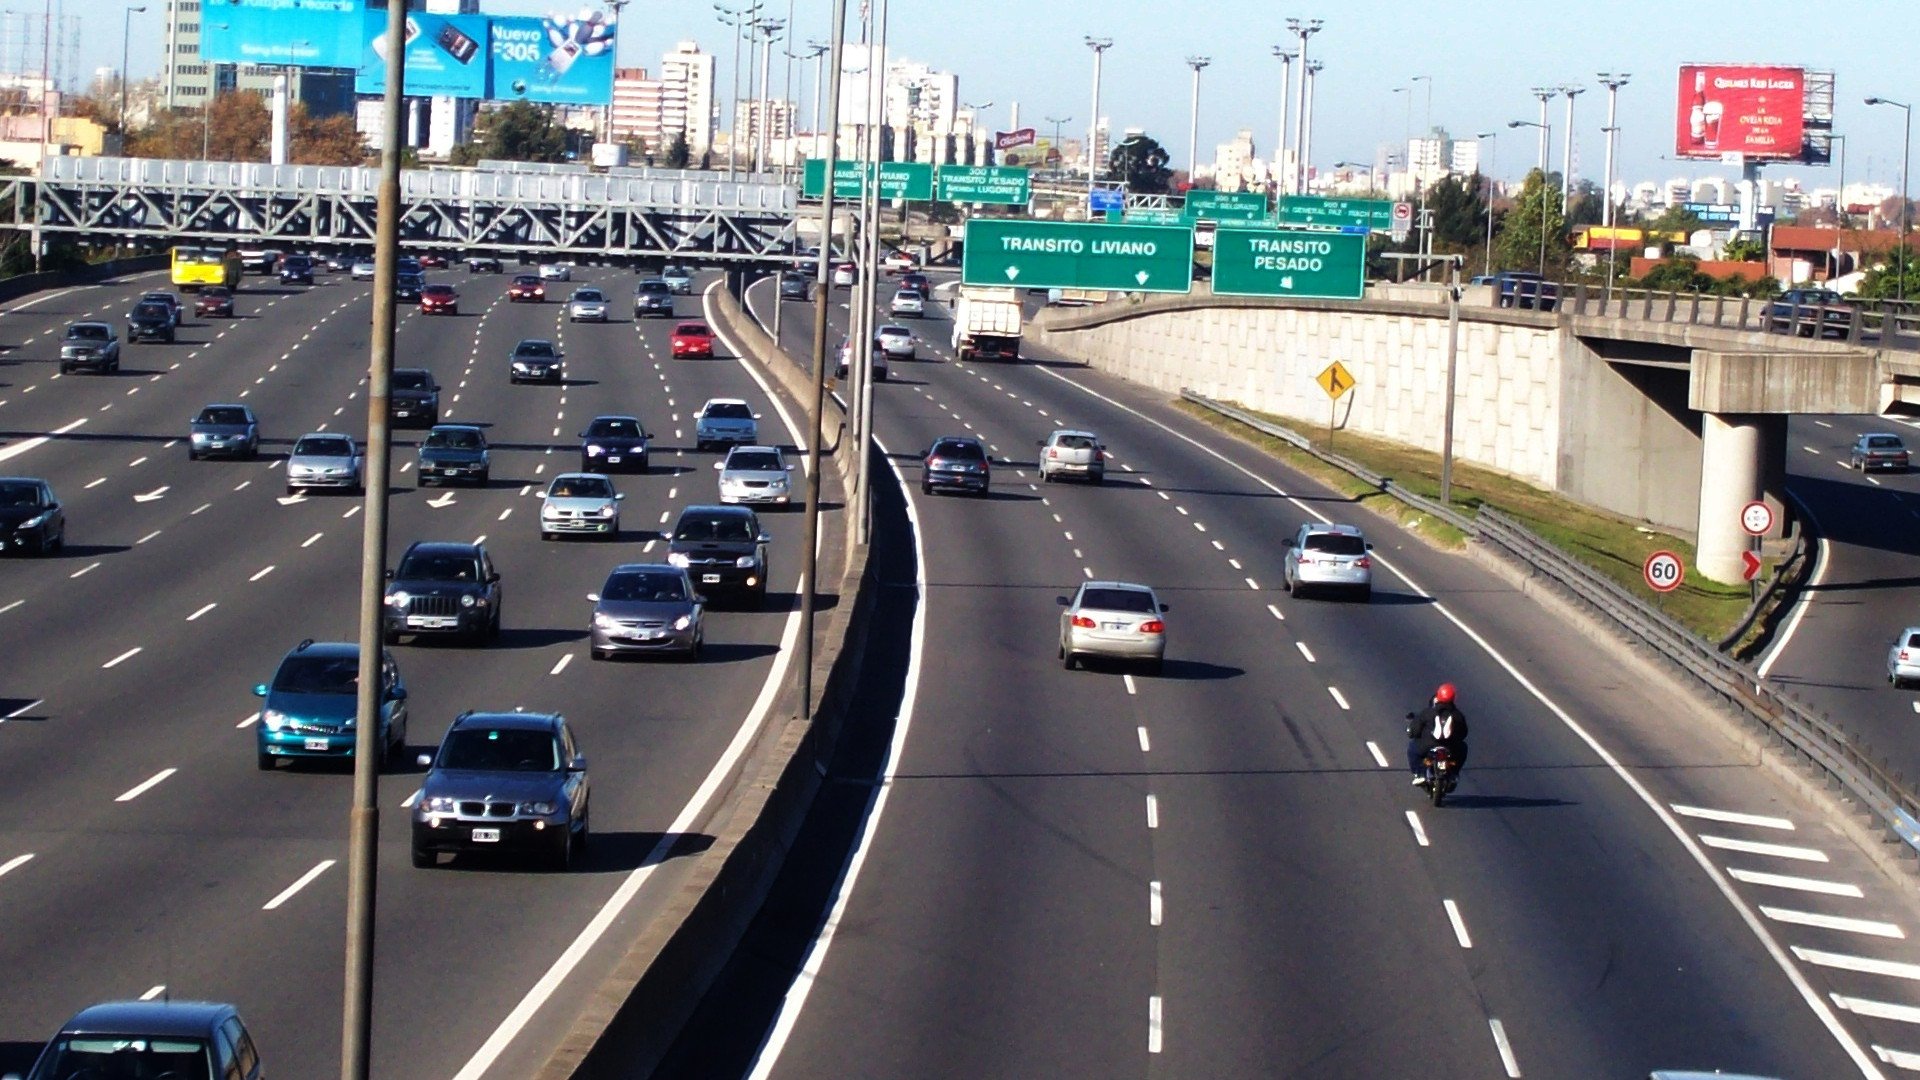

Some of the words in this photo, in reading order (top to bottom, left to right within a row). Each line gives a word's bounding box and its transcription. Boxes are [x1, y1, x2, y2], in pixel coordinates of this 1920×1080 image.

[492, 25, 542, 40] Nuevo
[969, 168, 987, 176] 300
[942, 175, 986, 185] TRANSITO
[989, 177, 1025, 187] PESADO
[1000, 236, 1083, 253] TRANSITO
[1091, 240, 1157, 256] LIVIANO
[1248, 239, 1331, 255] TRANSITO
[1254, 256, 1322, 272] PESADO
[1651, 562, 1676, 580] 60
